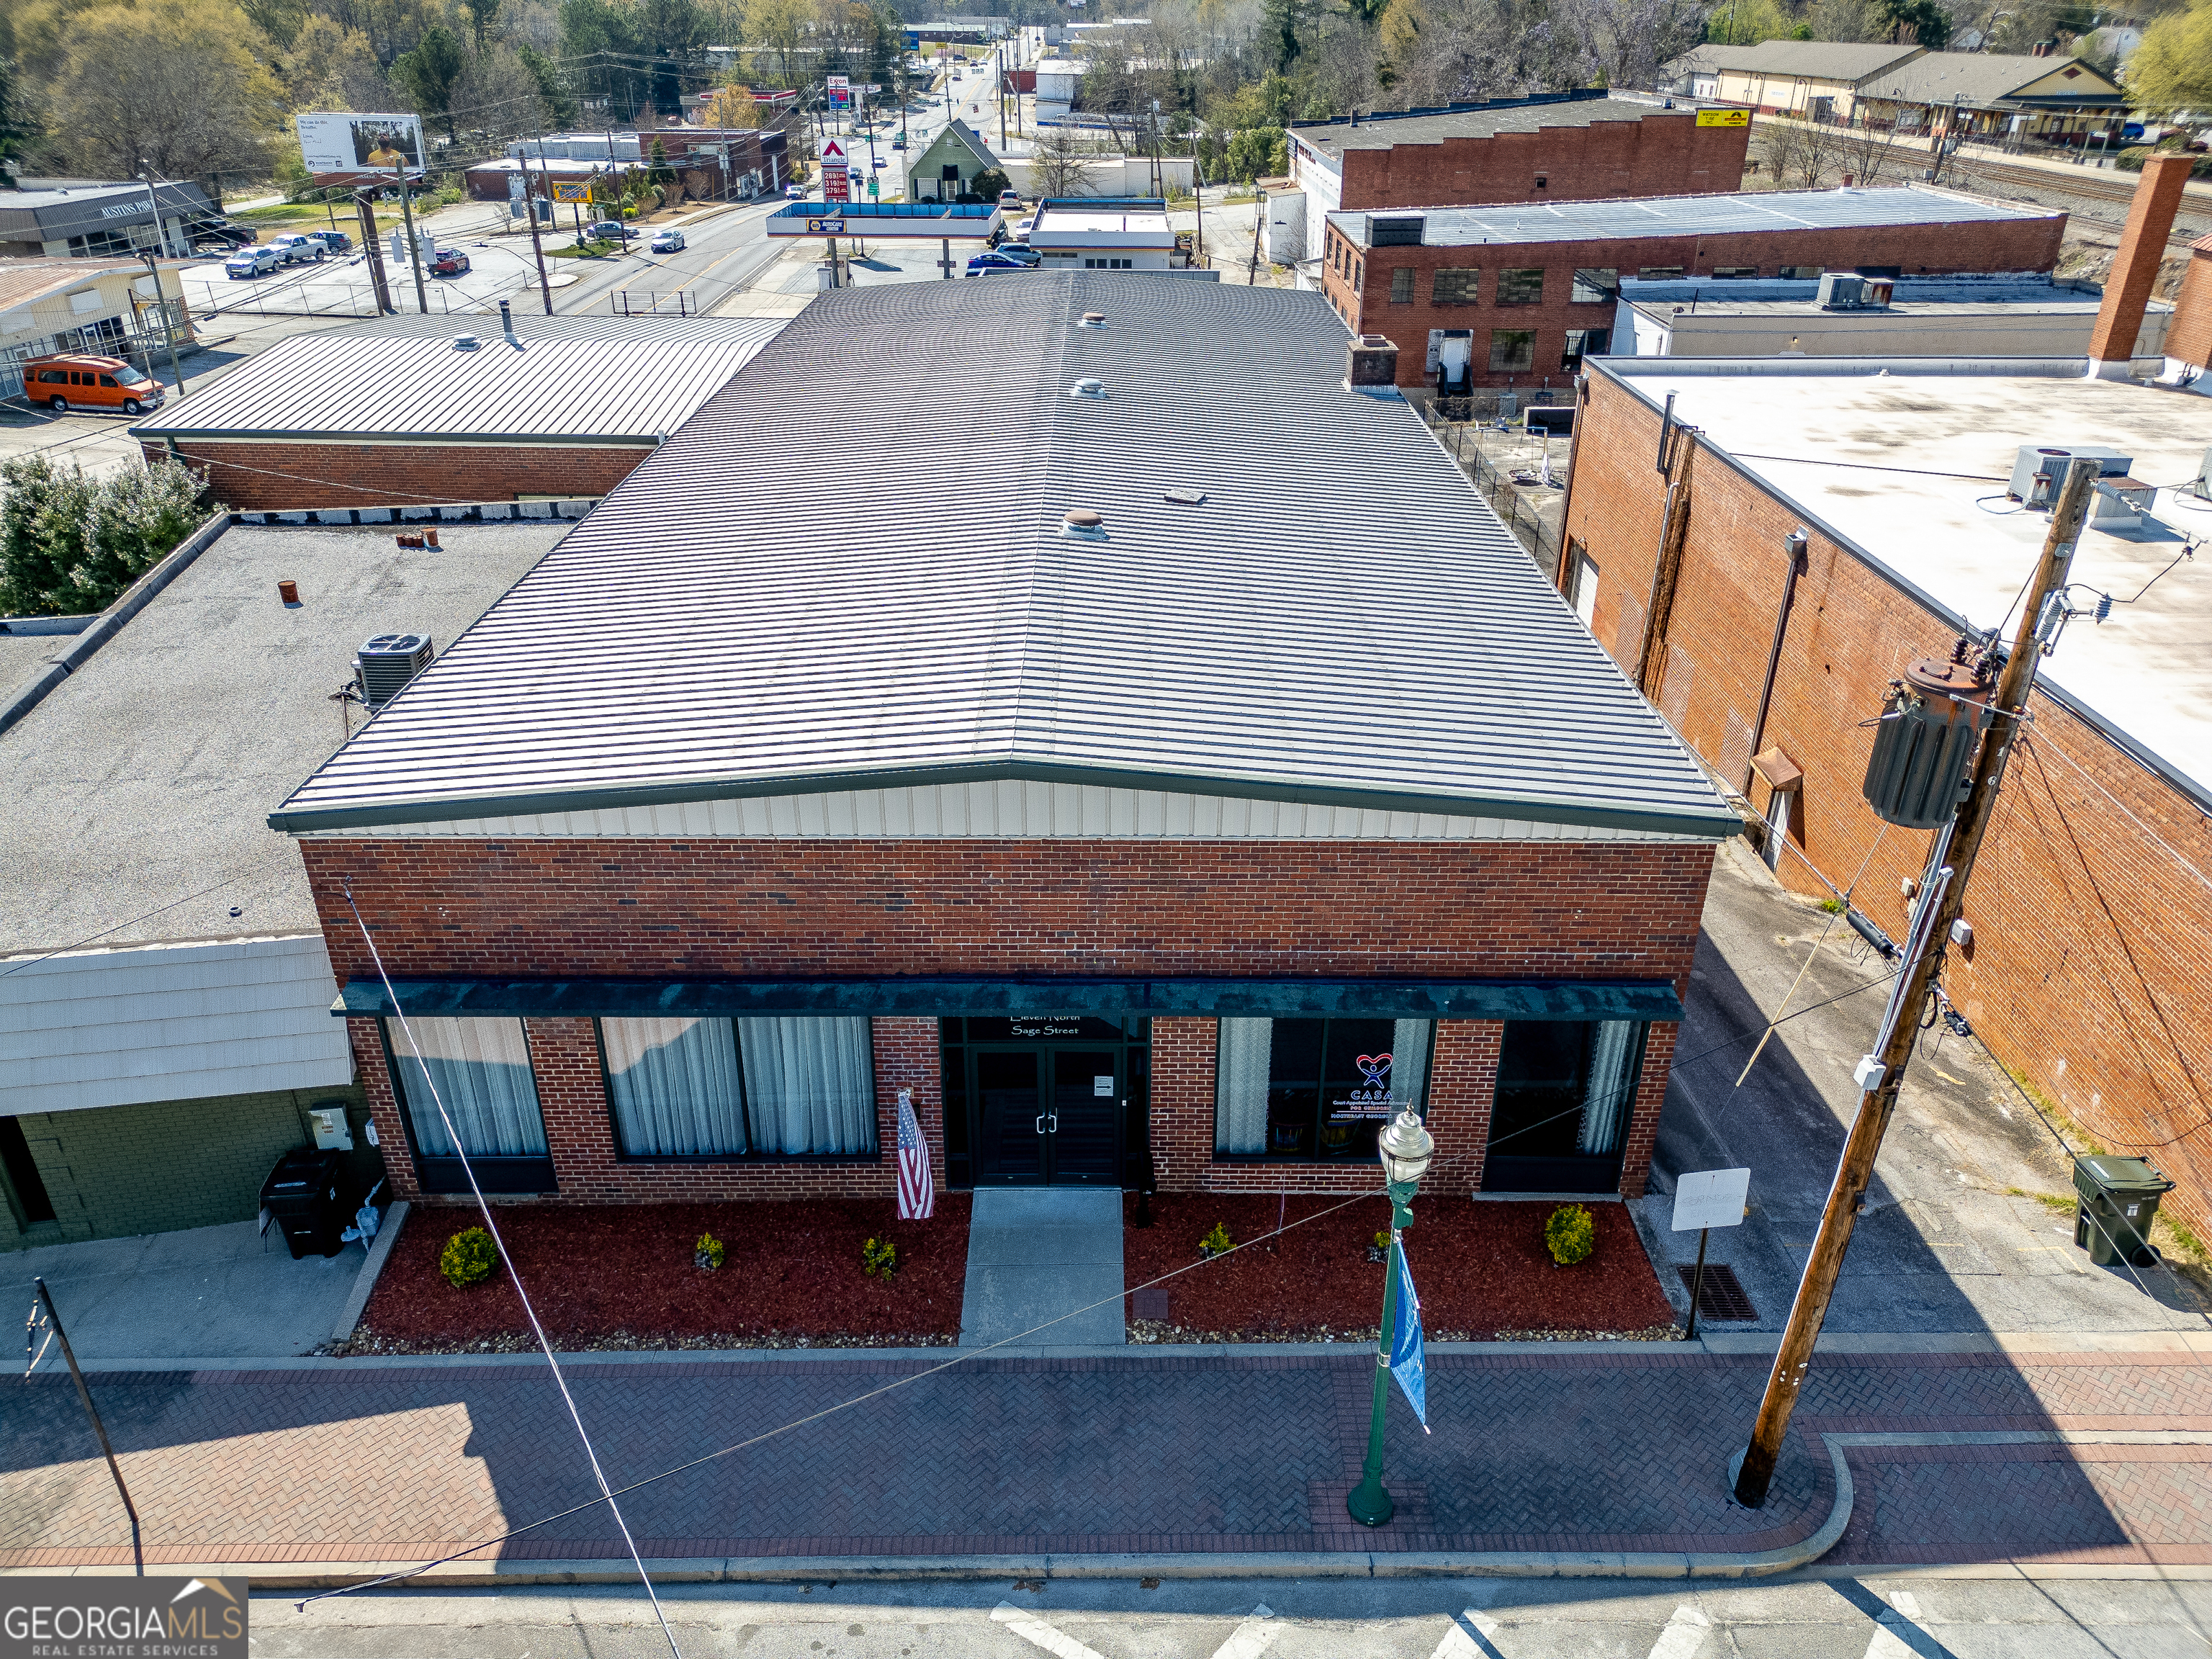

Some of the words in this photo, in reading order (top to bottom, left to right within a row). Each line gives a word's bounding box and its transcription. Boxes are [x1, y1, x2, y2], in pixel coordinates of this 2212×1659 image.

[1997, 746, 2005, 757] 1
[1987, 775, 1997, 786] 6
[1011, 1025, 1041, 1036] Sage
[1043, 1025, 1079, 1035] Street
[1351, 1090, 1394, 1100] CASA
